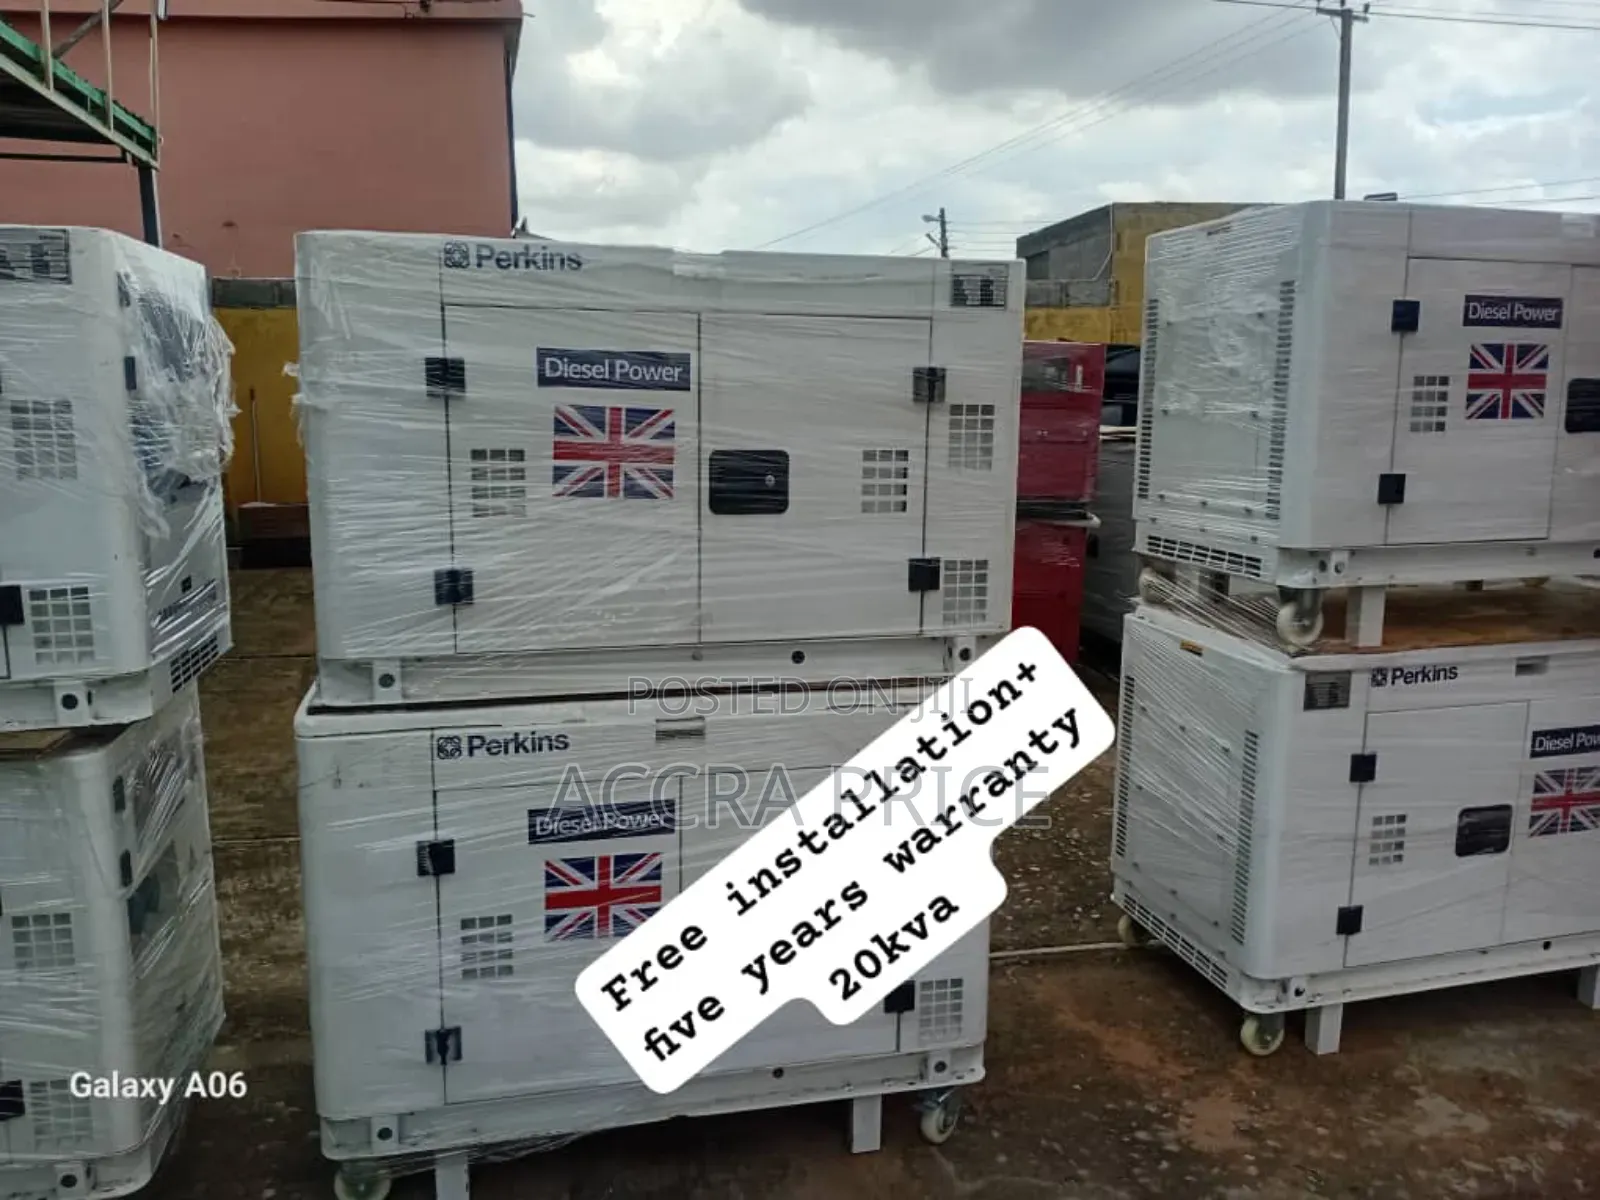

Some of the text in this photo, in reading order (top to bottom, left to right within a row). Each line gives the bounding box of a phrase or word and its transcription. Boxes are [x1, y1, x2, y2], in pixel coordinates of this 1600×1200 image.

[475, 243, 583, 271] Perkins
[1468, 302, 1558, 320] Diesel Power
[544, 357, 683, 382] Diesel Power
[1391, 664, 1459, 686] Perkins
[467, 731, 570, 757] Perkins
[1534, 733, 1575, 751] Diesel
[535, 814, 600, 835] Diesel
